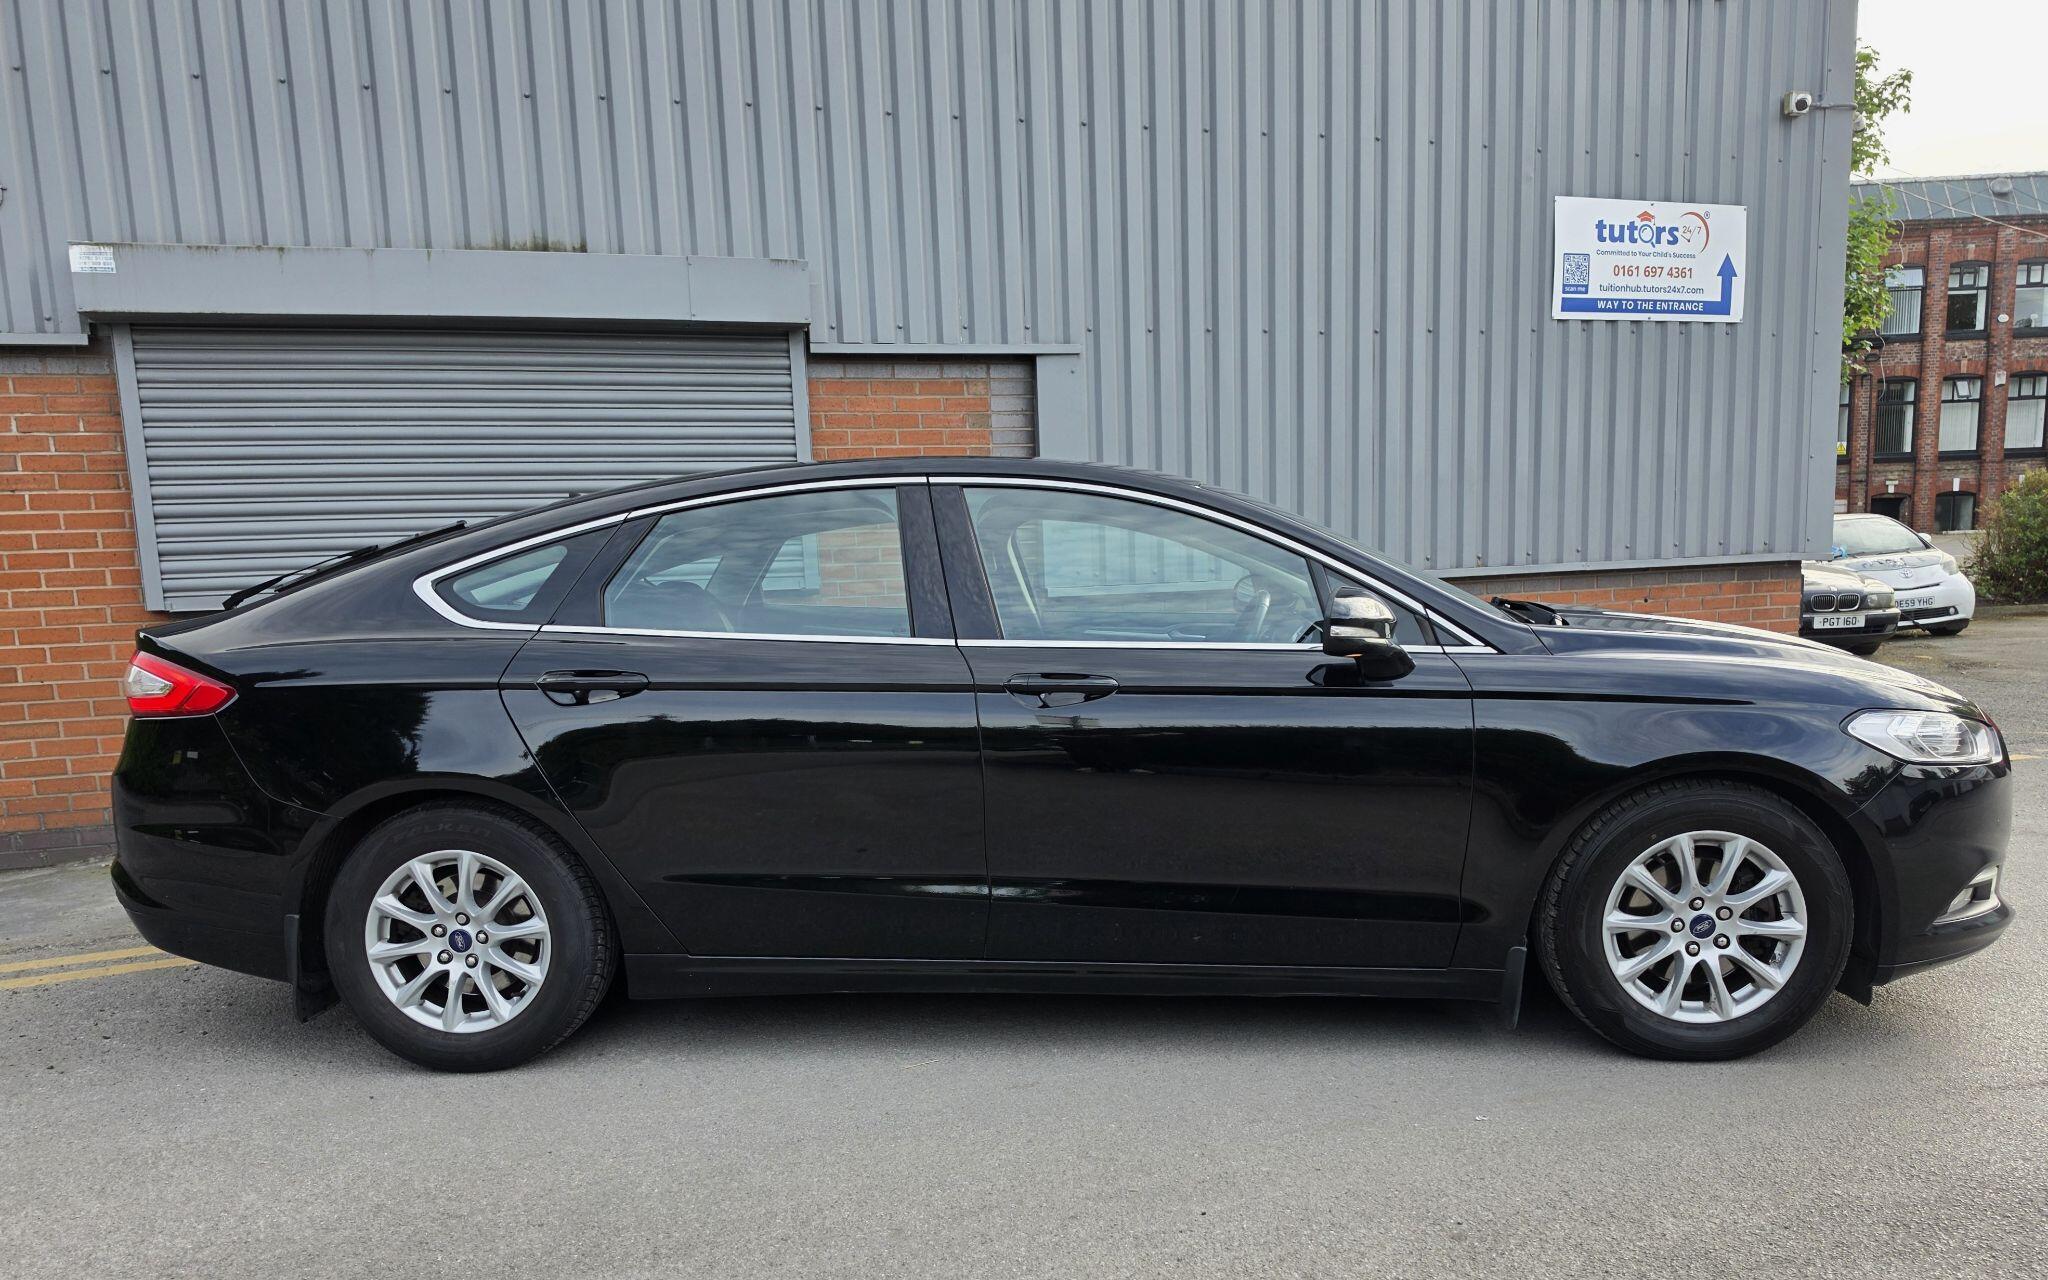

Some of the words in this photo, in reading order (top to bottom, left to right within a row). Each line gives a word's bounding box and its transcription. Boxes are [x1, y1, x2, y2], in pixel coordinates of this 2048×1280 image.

[1595, 217, 1679, 248] tutors
[1596, 249, 1630, 257] Committed
[1652, 251, 1671, 259] Child's
[1613, 265, 1640, 277] 0161
[1643, 265, 1664, 278] 697
[1667, 266, 1693, 279] 4361
[1599, 283, 1704, 295] tuitionhub.tutors24x7.com
[1597, 300, 1619, 309] WAY
[1621, 300, 1634, 310] TO
[1637, 301, 1653, 310] THE
[1656, 301, 1704, 311] ENTRANCE
[1917, 597, 1933, 606] YHG
[1822, 617, 1841, 627] PGT
[1843, 616, 1857, 626] 160
